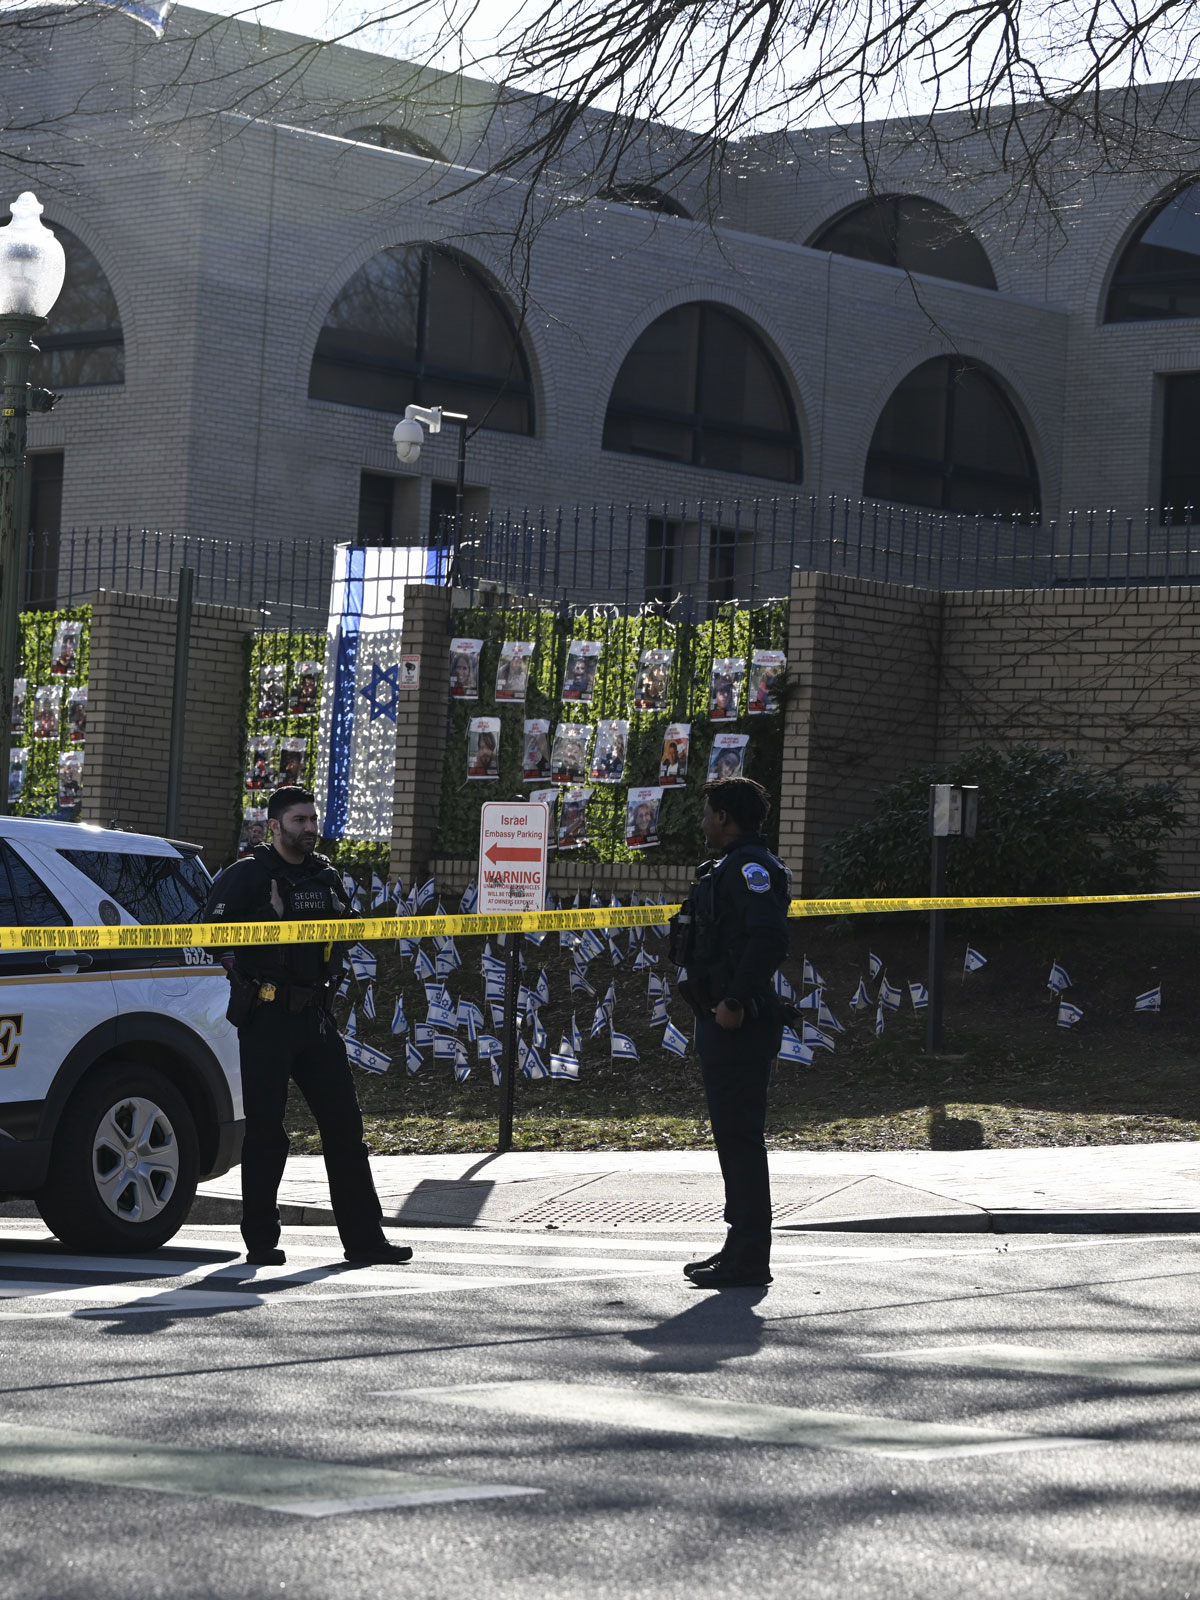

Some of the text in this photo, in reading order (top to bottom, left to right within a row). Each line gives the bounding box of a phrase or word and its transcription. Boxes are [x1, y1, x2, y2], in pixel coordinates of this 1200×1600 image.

[501, 814, 528, 825] Israel
[484, 830, 542, 840] Embassy Parking
[484, 870, 541, 884] WARNING
[294, 892, 323, 900] SECRET
[294, 901, 326, 909] SERVICE
